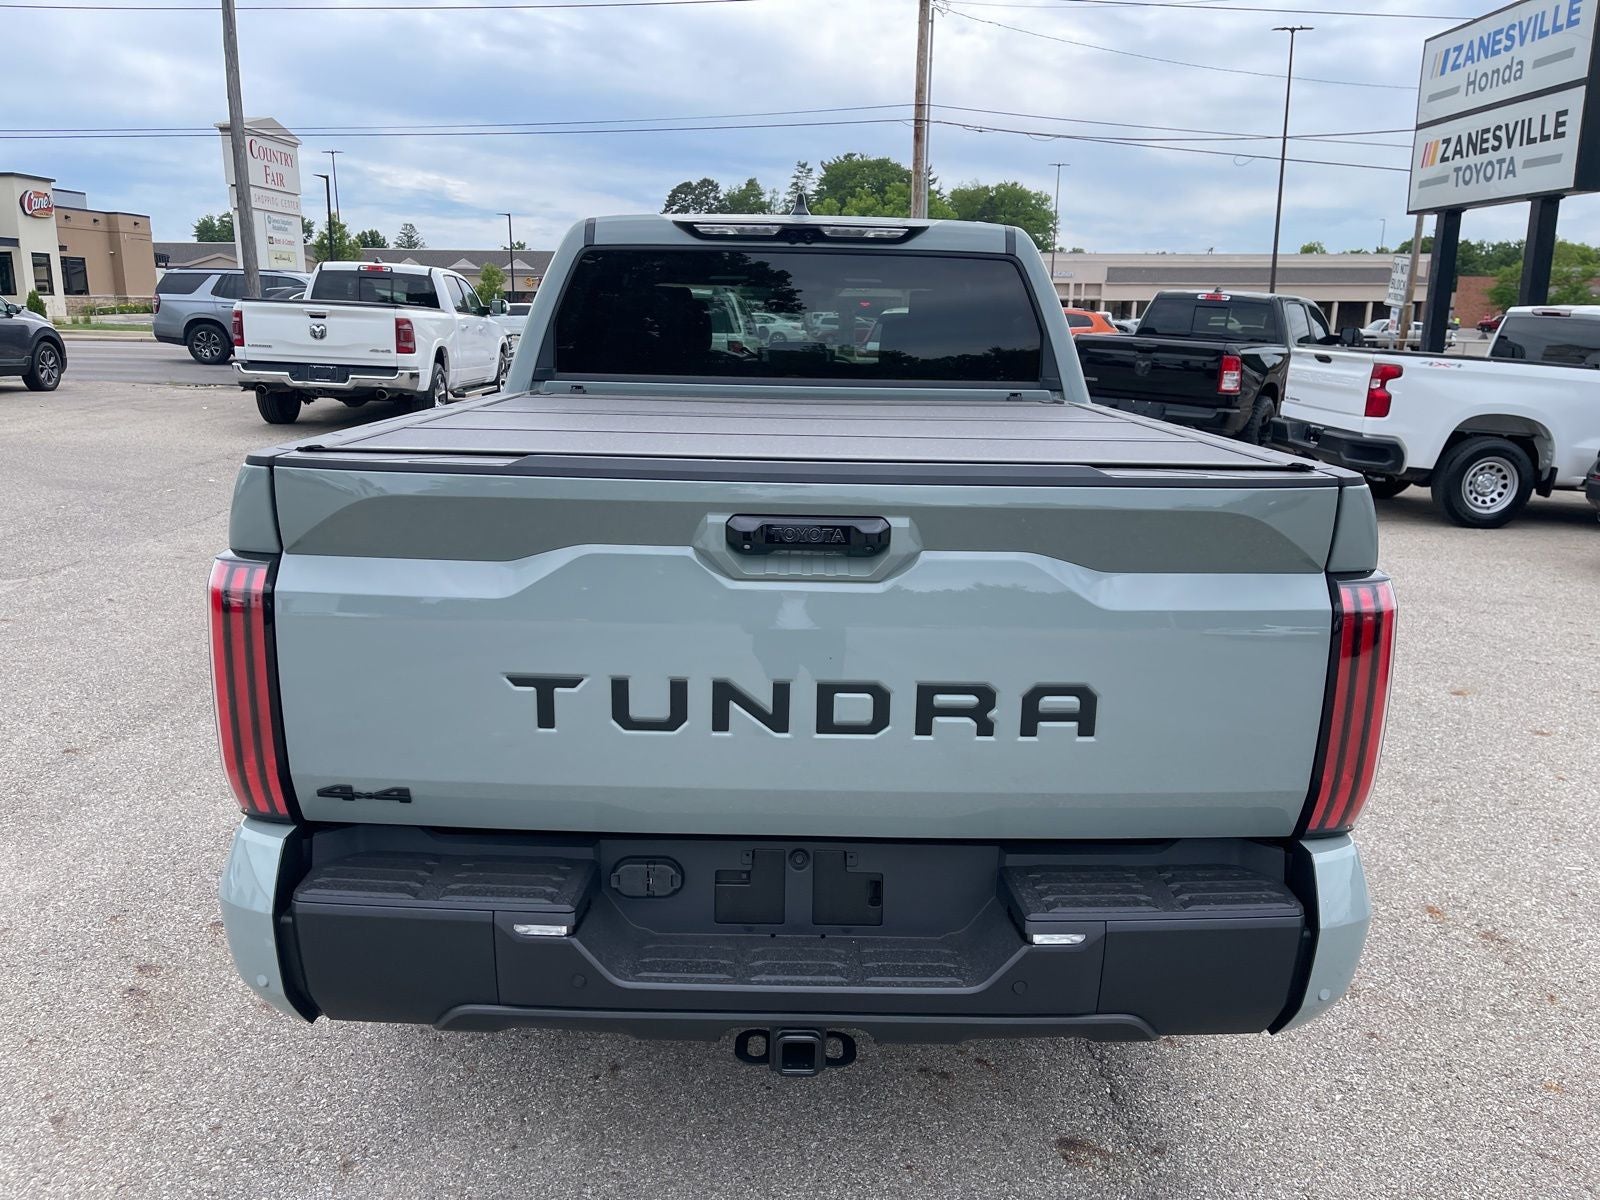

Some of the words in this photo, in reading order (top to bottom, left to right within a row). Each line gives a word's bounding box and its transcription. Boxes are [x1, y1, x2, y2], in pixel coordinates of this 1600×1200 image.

[1450, 0, 1583, 73] ZANESVILLE
[1465, 56, 1525, 97] Honda
[249, 138, 294, 169] COUNTRY
[1439, 109, 1569, 164] ZANESVILLE
[263, 164, 286, 188] FAIR
[1453, 156, 1517, 188] TOYOTA
[770, 526, 847, 544] TOYOTA
[502, 673, 1099, 742] TUNDRA
